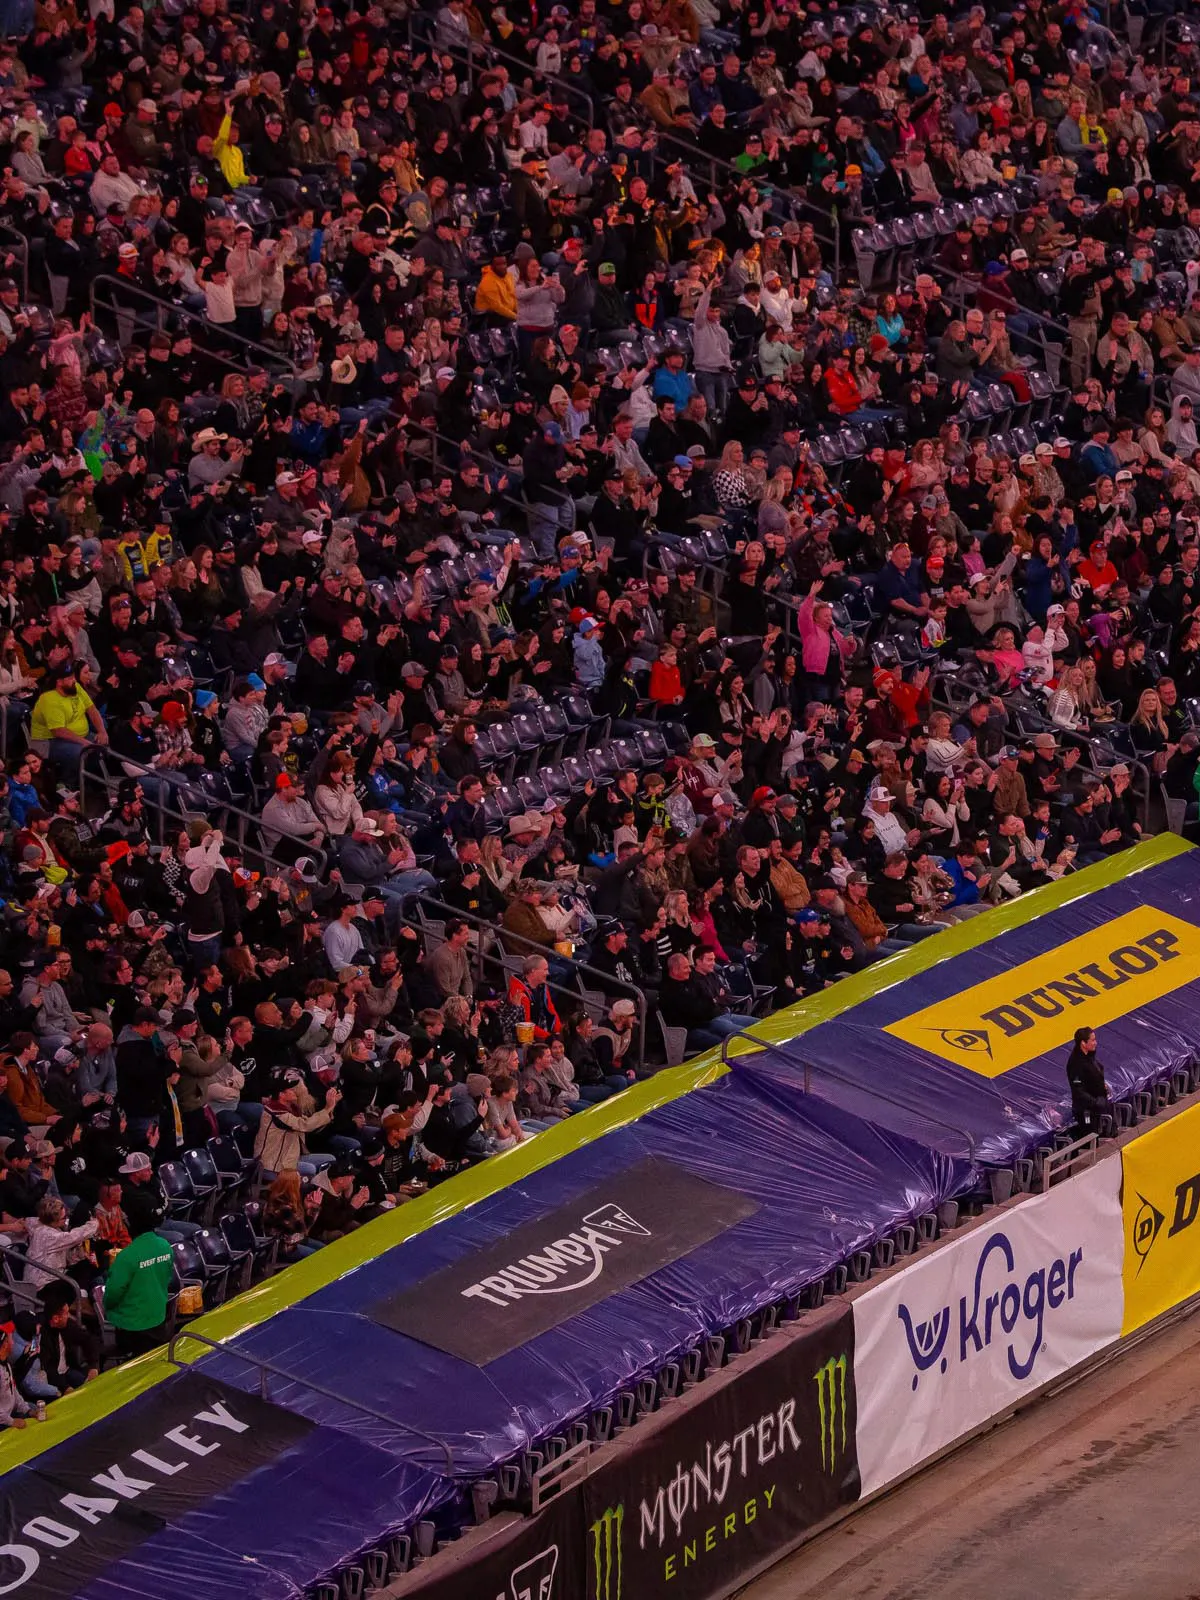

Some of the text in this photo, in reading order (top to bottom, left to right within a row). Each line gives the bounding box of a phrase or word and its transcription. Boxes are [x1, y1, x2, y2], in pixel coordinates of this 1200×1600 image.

[980, 928, 1180, 1037] DUNLOP
[139, 1253, 171, 1269] EVENT STAFF
[460, 1226, 623, 1307] TRIUMPH
[960, 1233, 1083, 1380] Kroger
[22, 1402, 250, 1548] OAKLEY
[638, 1397, 801, 1550] MONSTER
[664, 1485, 777, 1581] ENERGY
